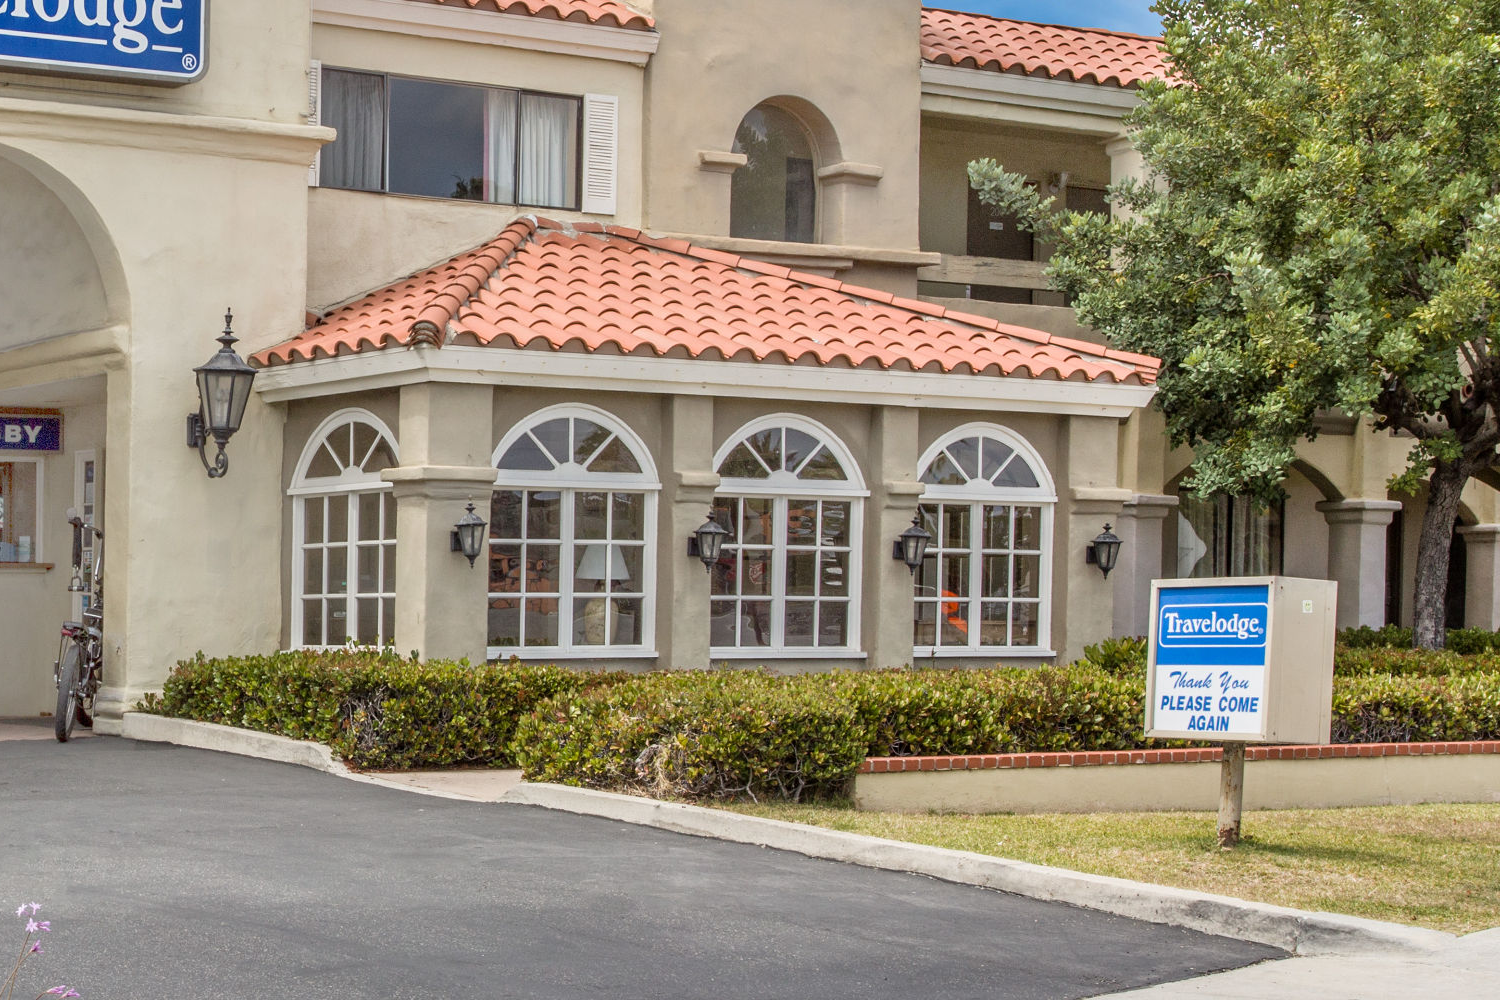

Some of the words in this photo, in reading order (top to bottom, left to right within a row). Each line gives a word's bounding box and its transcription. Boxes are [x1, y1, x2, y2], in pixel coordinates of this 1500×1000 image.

[1164, 610, 1259, 640] Travelodge
[1169, 670, 1213, 689] Thank
[1218, 670, 1250, 695] You
[1160, 695, 1213, 712] PLEASE
[1218, 696, 1260, 713] COME
[1187, 715, 1230, 732] AGAIN
